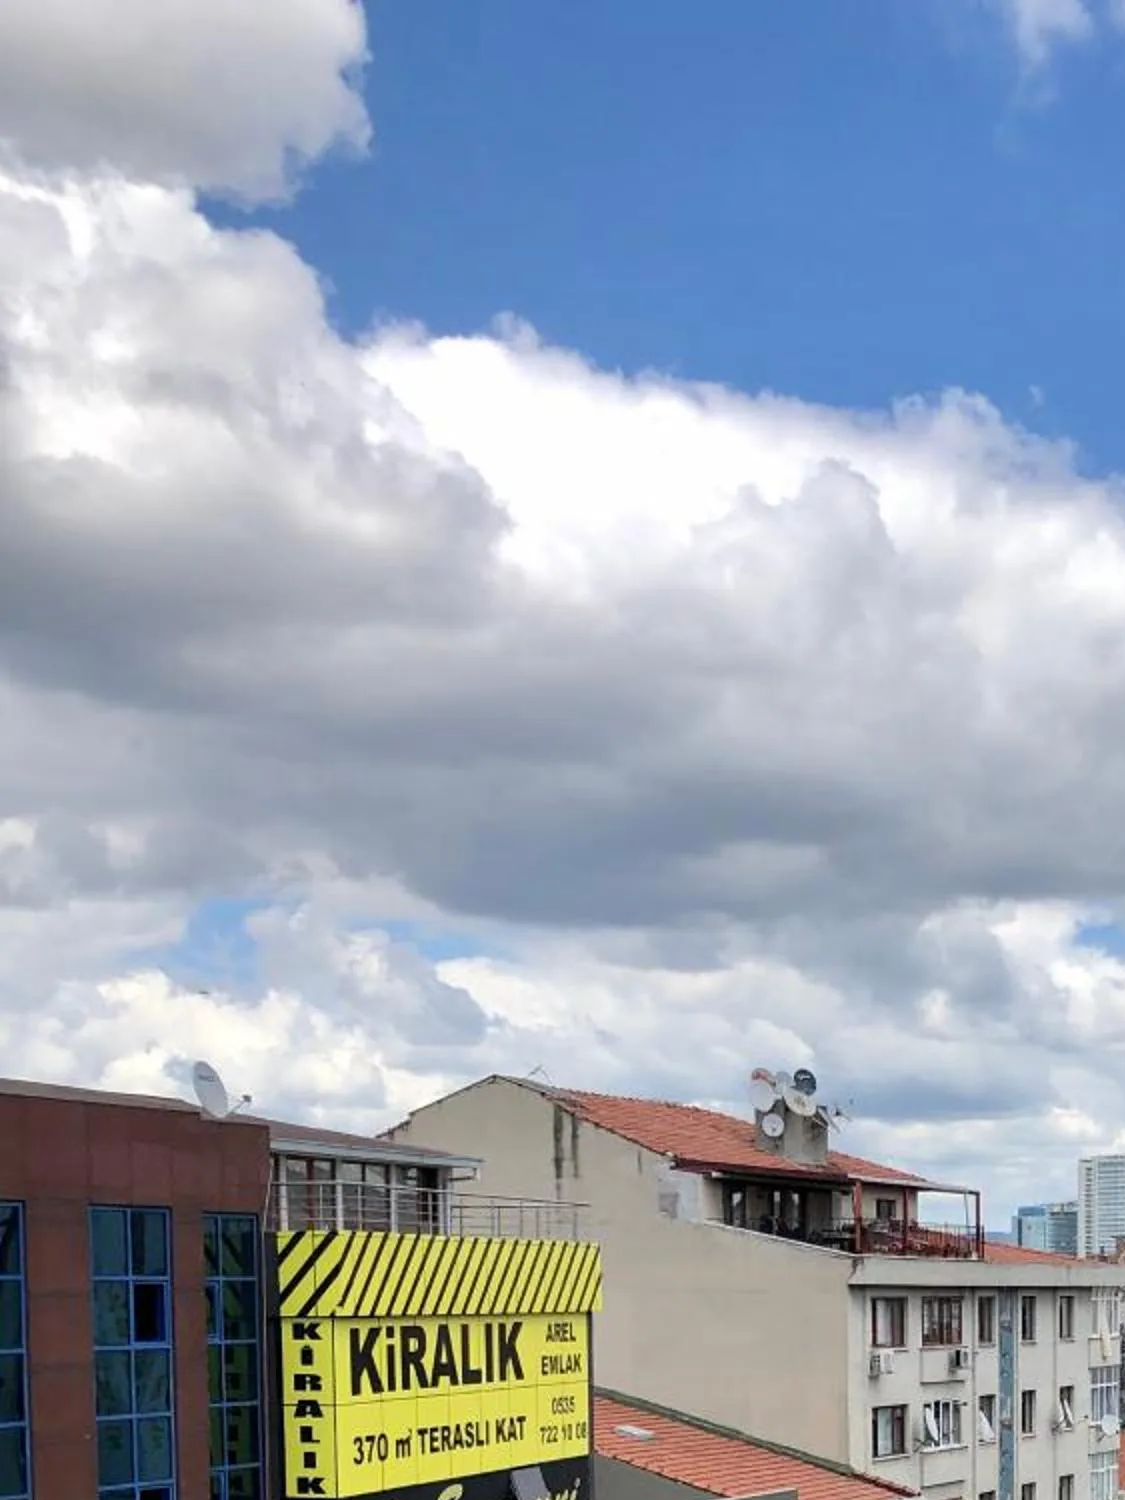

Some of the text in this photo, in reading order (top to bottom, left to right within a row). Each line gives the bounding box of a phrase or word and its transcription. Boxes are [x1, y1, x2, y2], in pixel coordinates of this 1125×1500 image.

[546, 1322, 576, 1342] AREL
[541, 1353, 582, 1375] EMLAK
[353, 1433, 388, 1464] 370
[417, 1420, 489, 1455] TERASLI
[495, 1416, 526, 1443] KAT
